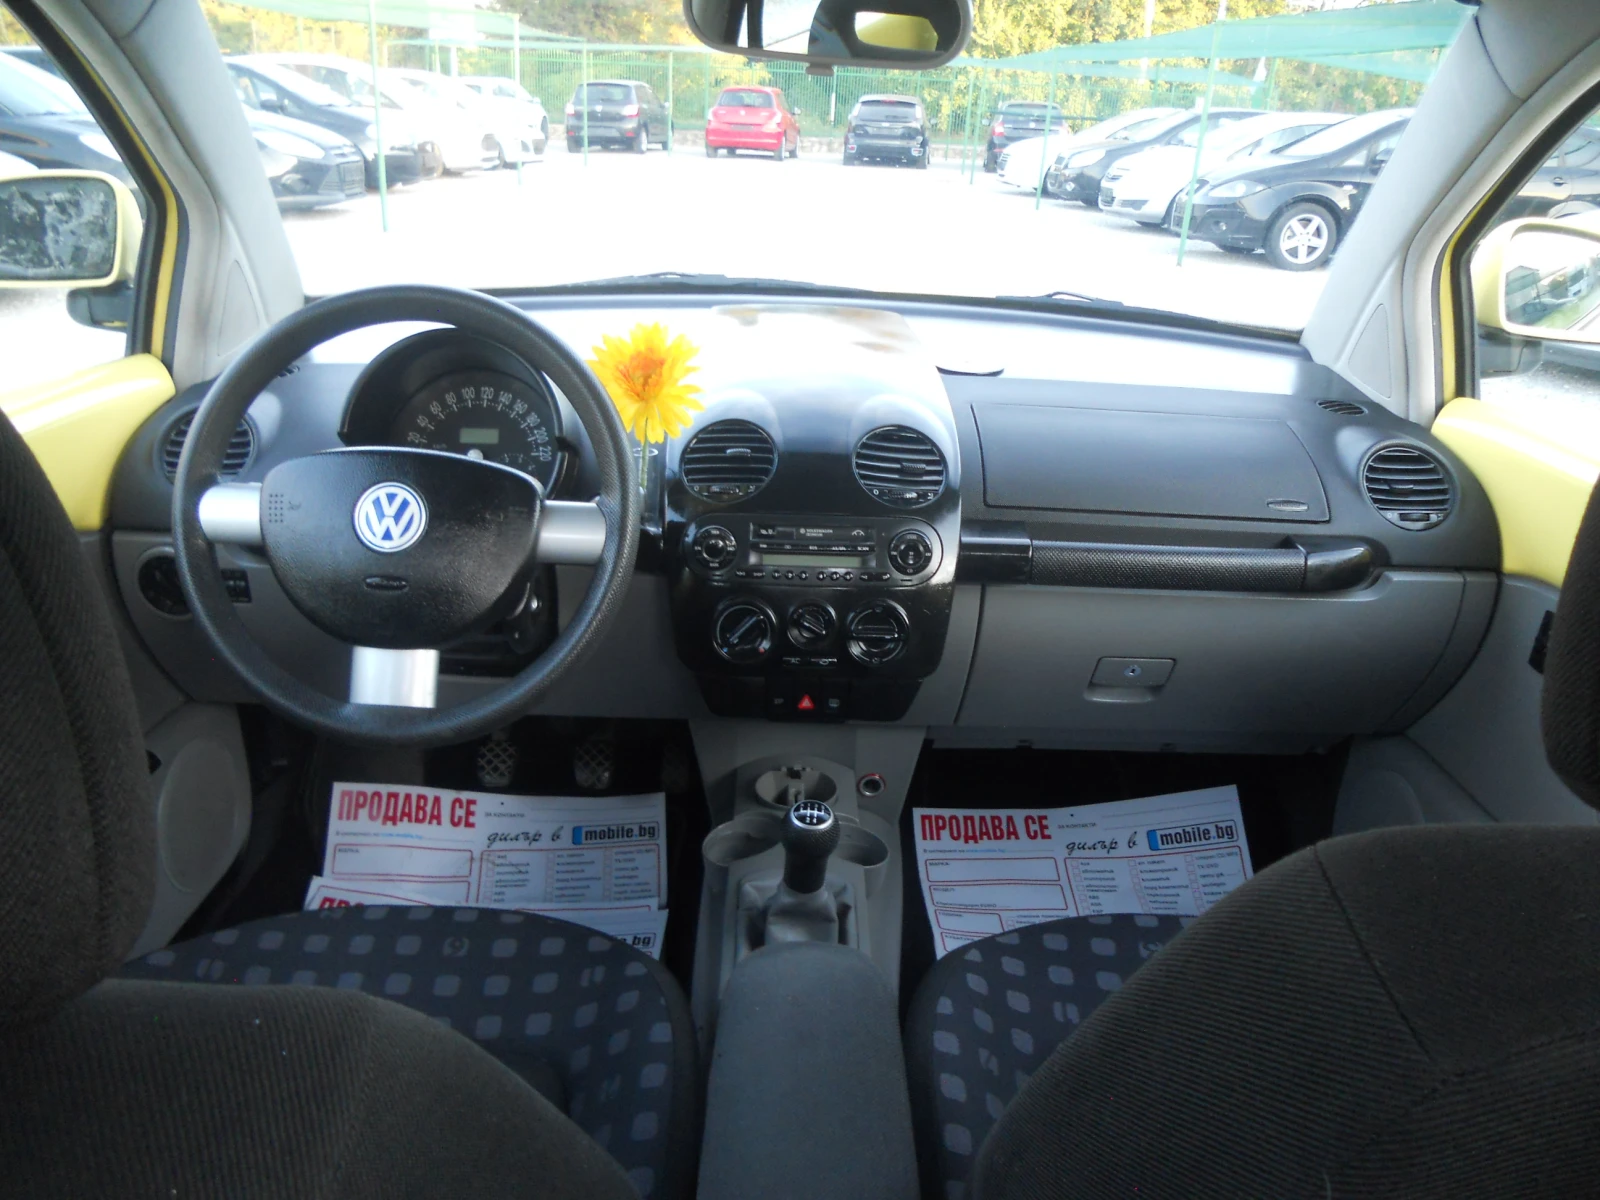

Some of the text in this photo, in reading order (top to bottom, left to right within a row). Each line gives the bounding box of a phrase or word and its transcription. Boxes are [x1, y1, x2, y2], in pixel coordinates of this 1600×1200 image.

[461, 386, 476, 400] 100
[480, 386, 495, 400] 120
[498, 390, 513, 405] 140
[429, 401, 442, 414] 60
[416, 414, 429, 427] 40
[534, 426, 549, 444] 200
[539, 445, 552, 462] 220
[361, 486, 420, 550] VW
[338, 789, 477, 829] ПРОДАВА СЕ
[584, 824, 656, 841] mobile.bg
[920, 813, 1052, 845] ПРОДАВА СЕ
[1160, 823, 1235, 846] mobile.bg
[1065, 837, 1120, 856] дилър
